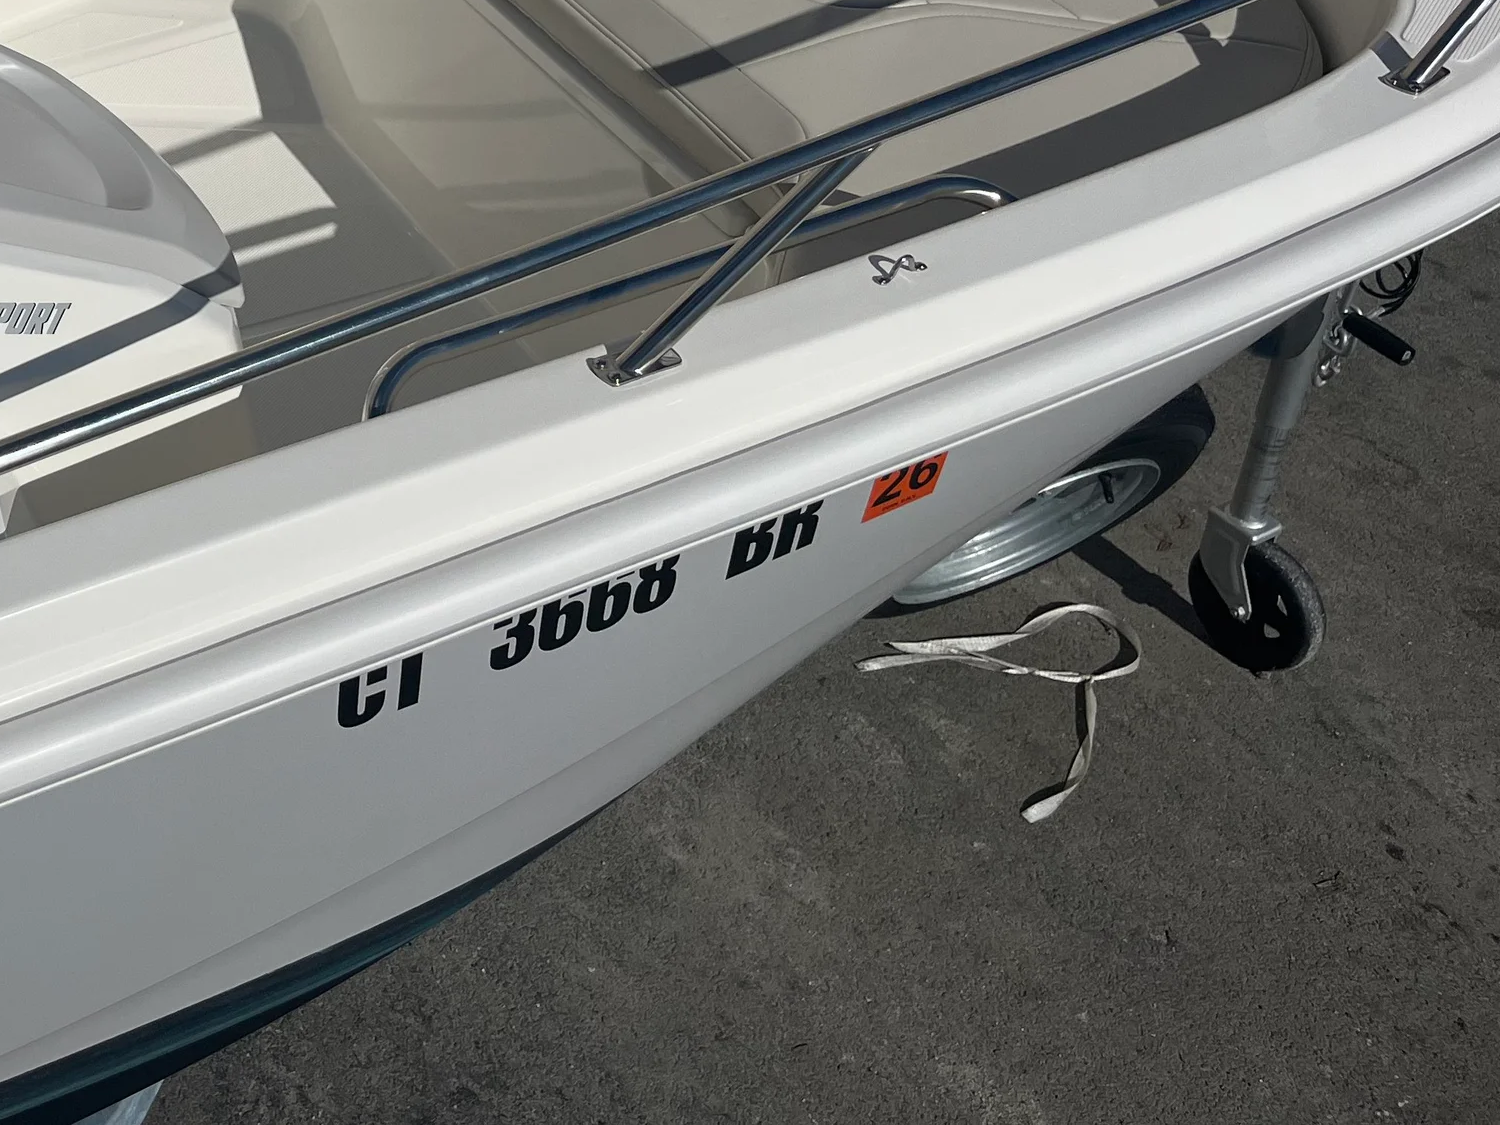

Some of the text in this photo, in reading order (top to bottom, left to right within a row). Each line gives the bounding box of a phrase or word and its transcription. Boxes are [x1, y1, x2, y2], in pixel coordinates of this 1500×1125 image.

[871, 454, 942, 508] 26
[489, 553, 681, 671] 3668
[725, 499, 824, 580] BR
